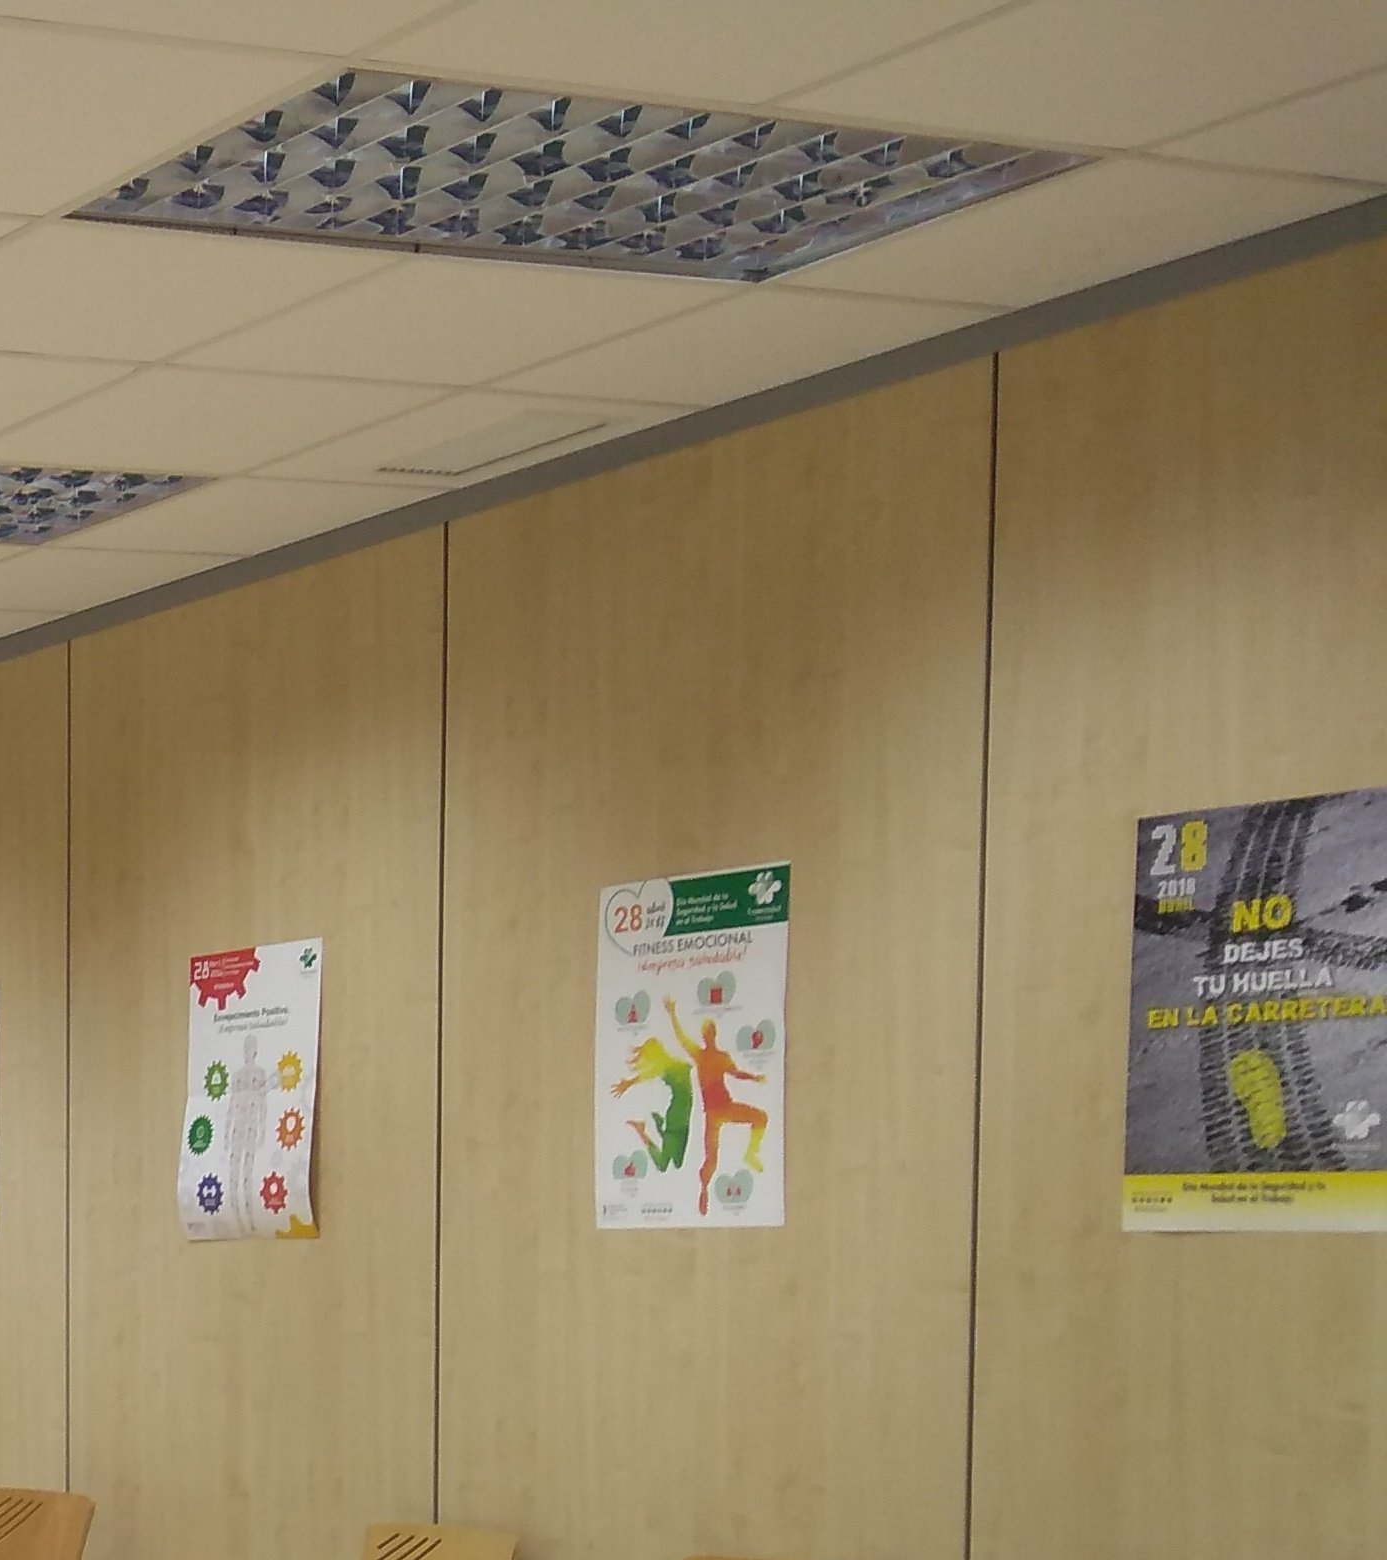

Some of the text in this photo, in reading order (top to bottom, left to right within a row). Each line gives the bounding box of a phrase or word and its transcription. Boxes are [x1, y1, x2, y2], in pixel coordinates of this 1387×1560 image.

[1150, 820, 1208, 876] 28
[614, 904, 643, 933] 28
[1232, 894, 1293, 934] NO
[634, 931, 753, 956] FITNESS EMOCIONAL
[1223, 938, 1304, 965] DEJES
[194, 961, 210, 981] 28
[1193, 966, 1334, 997] TU HUELLA
[1148, 995, 1387, 1029] EN LA CARRETERA
